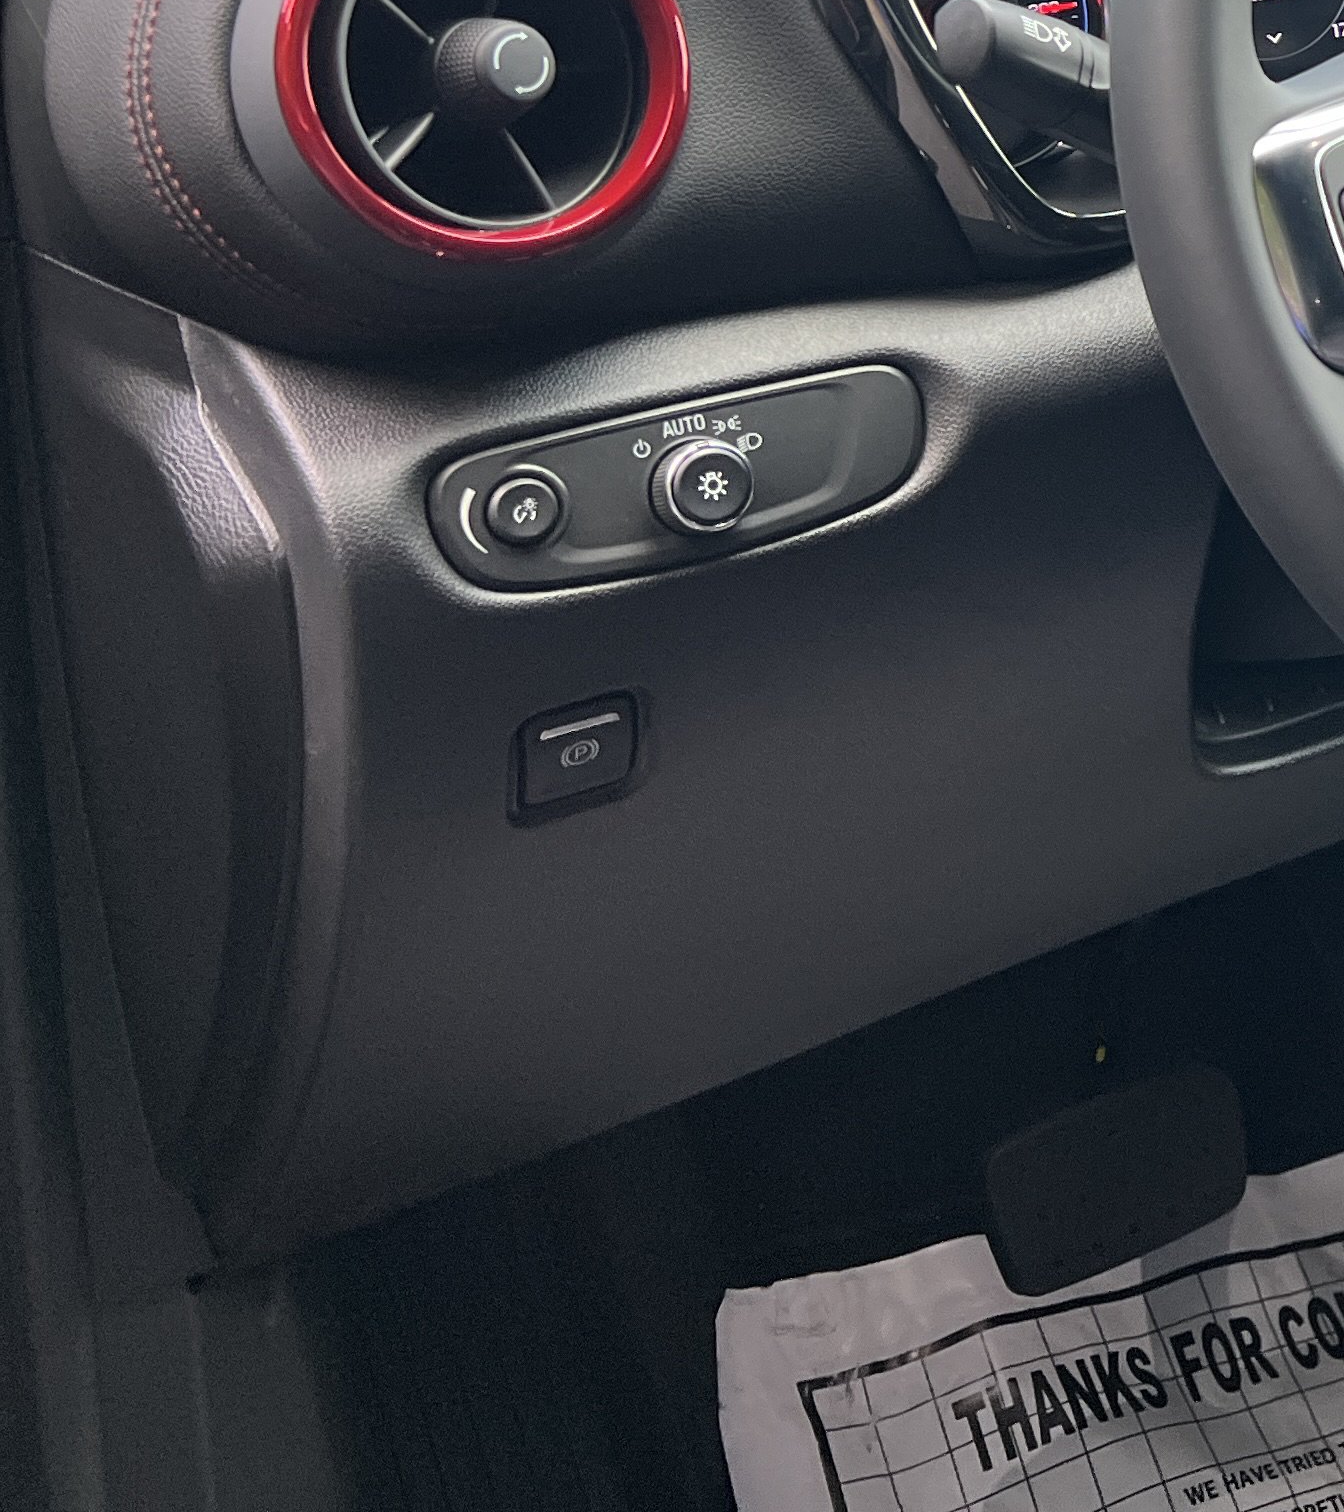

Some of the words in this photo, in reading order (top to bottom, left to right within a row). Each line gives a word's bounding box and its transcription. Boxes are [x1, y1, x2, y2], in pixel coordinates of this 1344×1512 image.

[662, 414, 706, 438] AUTO
[952, 1345, 1168, 1472] THANKS
[1169, 1316, 1279, 1402] FOR
[1184, 1479, 1219, 1506] WE
[1222, 1462, 1279, 1493] HAVE
[1280, 1447, 1336, 1475] TRIED
